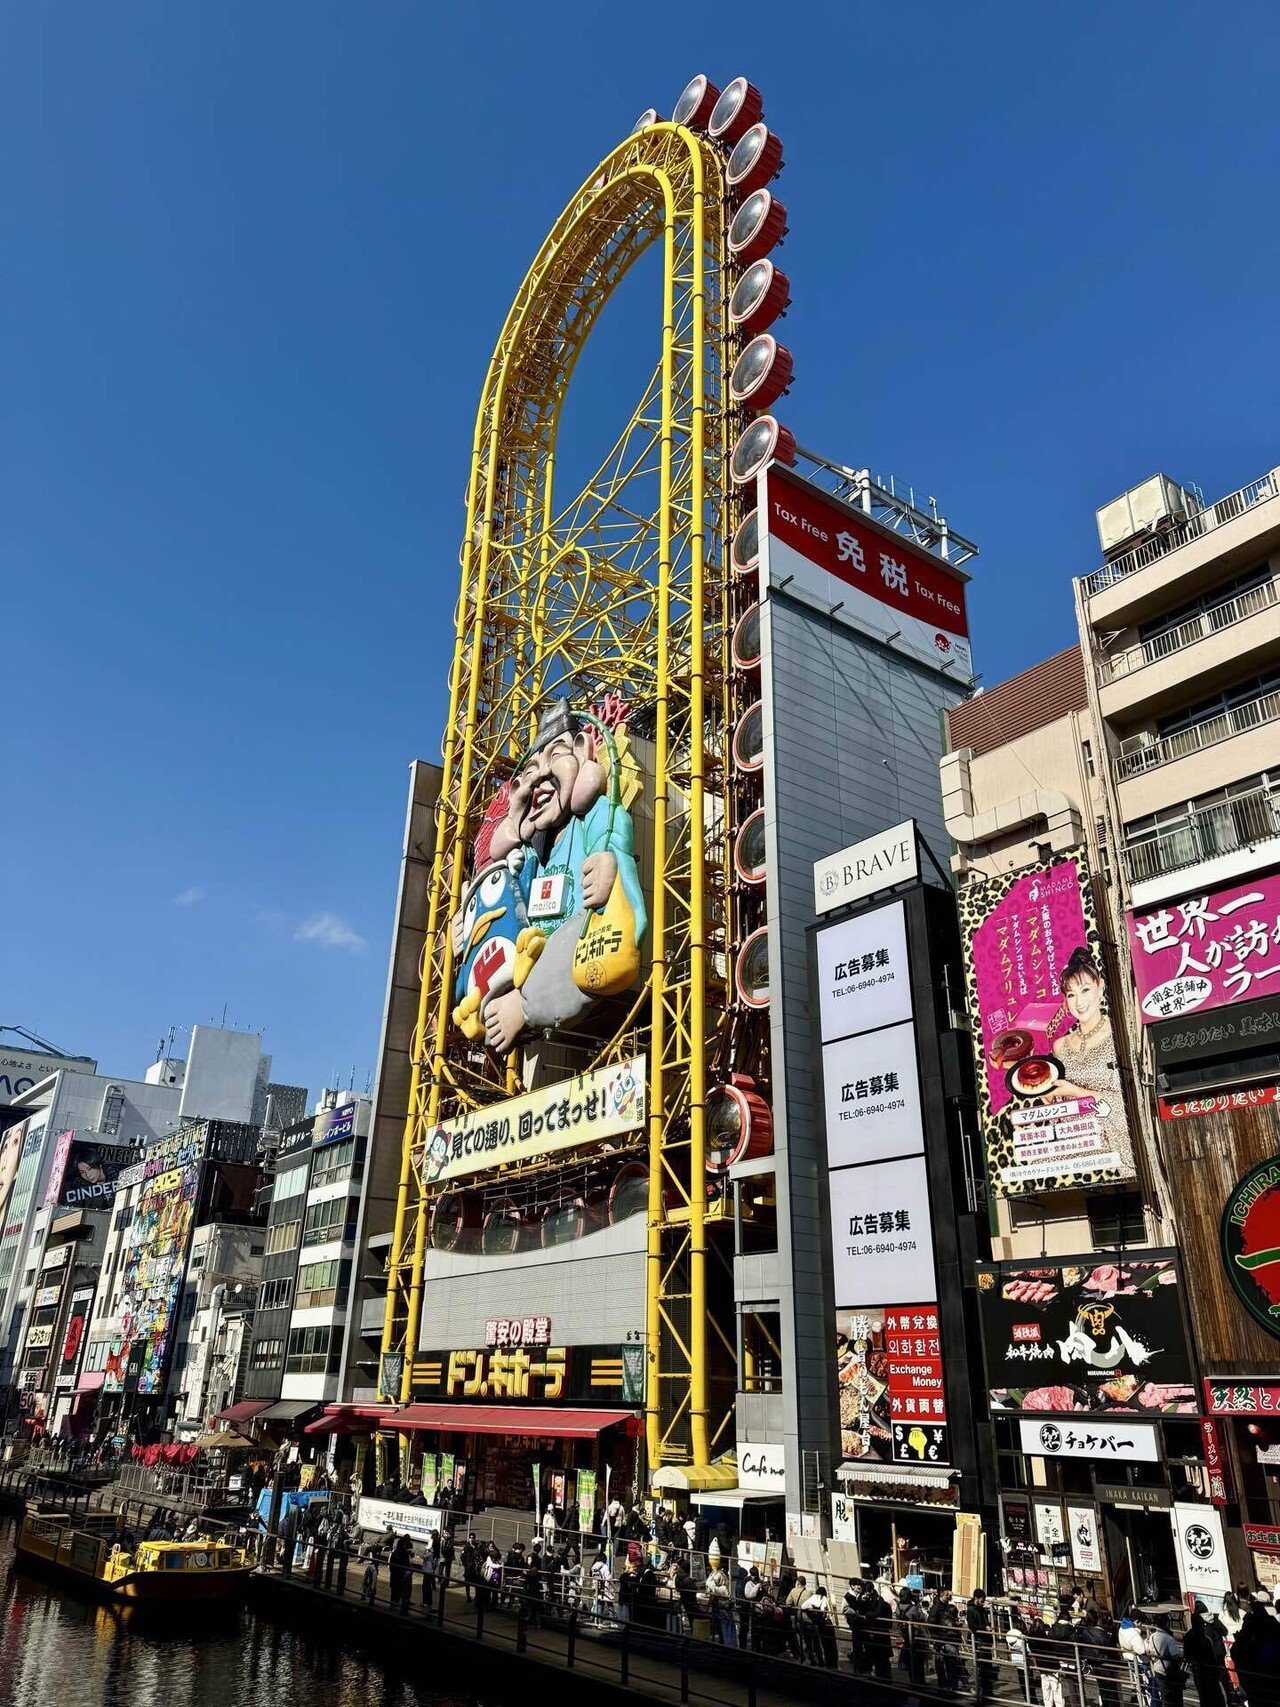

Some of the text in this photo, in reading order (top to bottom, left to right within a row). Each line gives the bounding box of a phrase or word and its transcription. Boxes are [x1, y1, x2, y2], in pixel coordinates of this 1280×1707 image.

[774, 502, 829, 542] Tax Free
[835, 530, 909, 597] 免税
[914, 581, 961, 616] Tax Free
[843, 840, 910, 886] BRAVE
[1040, 876, 1073, 891] MADAME
[1040, 882, 1074, 898] SHINCO
[1136, 891, 1266, 954] 世界一
[1011, 914, 1029, 996] マダムシンコといえば
[1040, 904, 1060, 996] 大阪のおみやげといえば
[473, 940, 507, 998] ド
[834, 947, 890, 981] 広告募集
[831, 972, 895, 999] TEL:06-6940-4974
[1144, 979, 1208, 1009] 一蘭全店舗中
[1160, 996, 1197, 1016] 世界一
[1160, 1024, 1235, 1052] こだわりたい
[841, 1071, 900, 1103] 広告募集
[838, 1098, 906, 1122] TEL:06-6940-4974
[1020, 1105, 1069, 1121] マダムシンコ
[1058, 1121, 1095, 1136] 大丸梅田店
[849, 1209, 911, 1237] 広告募集
[846, 1240, 917, 1257] TEL:06-6940-4974
[485, 1316, 551, 1346] 驚安の殿堂
[887, 1315, 938, 1331] 外幣兌換
[888, 1339, 940, 1357] 외화환전
[1005, 1342, 1055, 1361] 和牛焼肉
[889, 1364, 932, 1376] Exchange
[912, 1376, 943, 1389] Money
[891, 1397, 945, 1414] 外貨両替
[1210, 1385, 1280, 1411] 天然と
[1065, 1431, 1135, 1452] チョケバー
[1203, 1421, 1219, 1466] ラーメン
[742, 1452, 767, 1478] Cafe
[1105, 1489, 1159, 1502] INAKA KAIKAN
